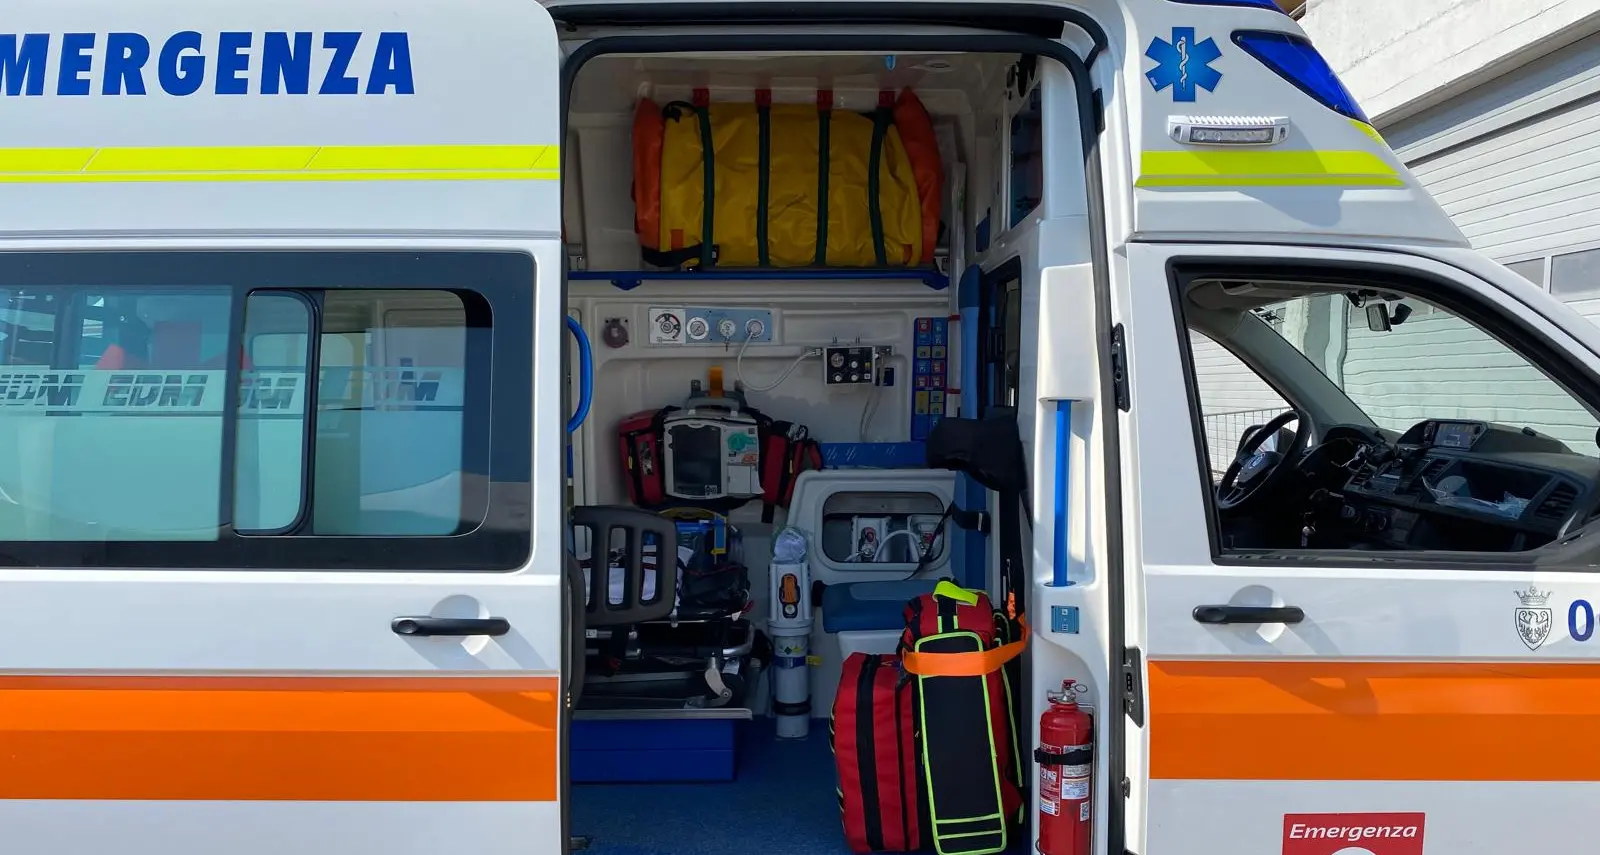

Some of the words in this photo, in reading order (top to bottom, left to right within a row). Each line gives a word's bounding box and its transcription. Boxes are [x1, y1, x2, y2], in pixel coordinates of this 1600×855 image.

[0, 31, 415, 96] MERGENZA
[102, 374, 209, 407] EDM
[1568, 599, 1600, 641] 0
[1289, 823, 1418, 841] Emergenza
